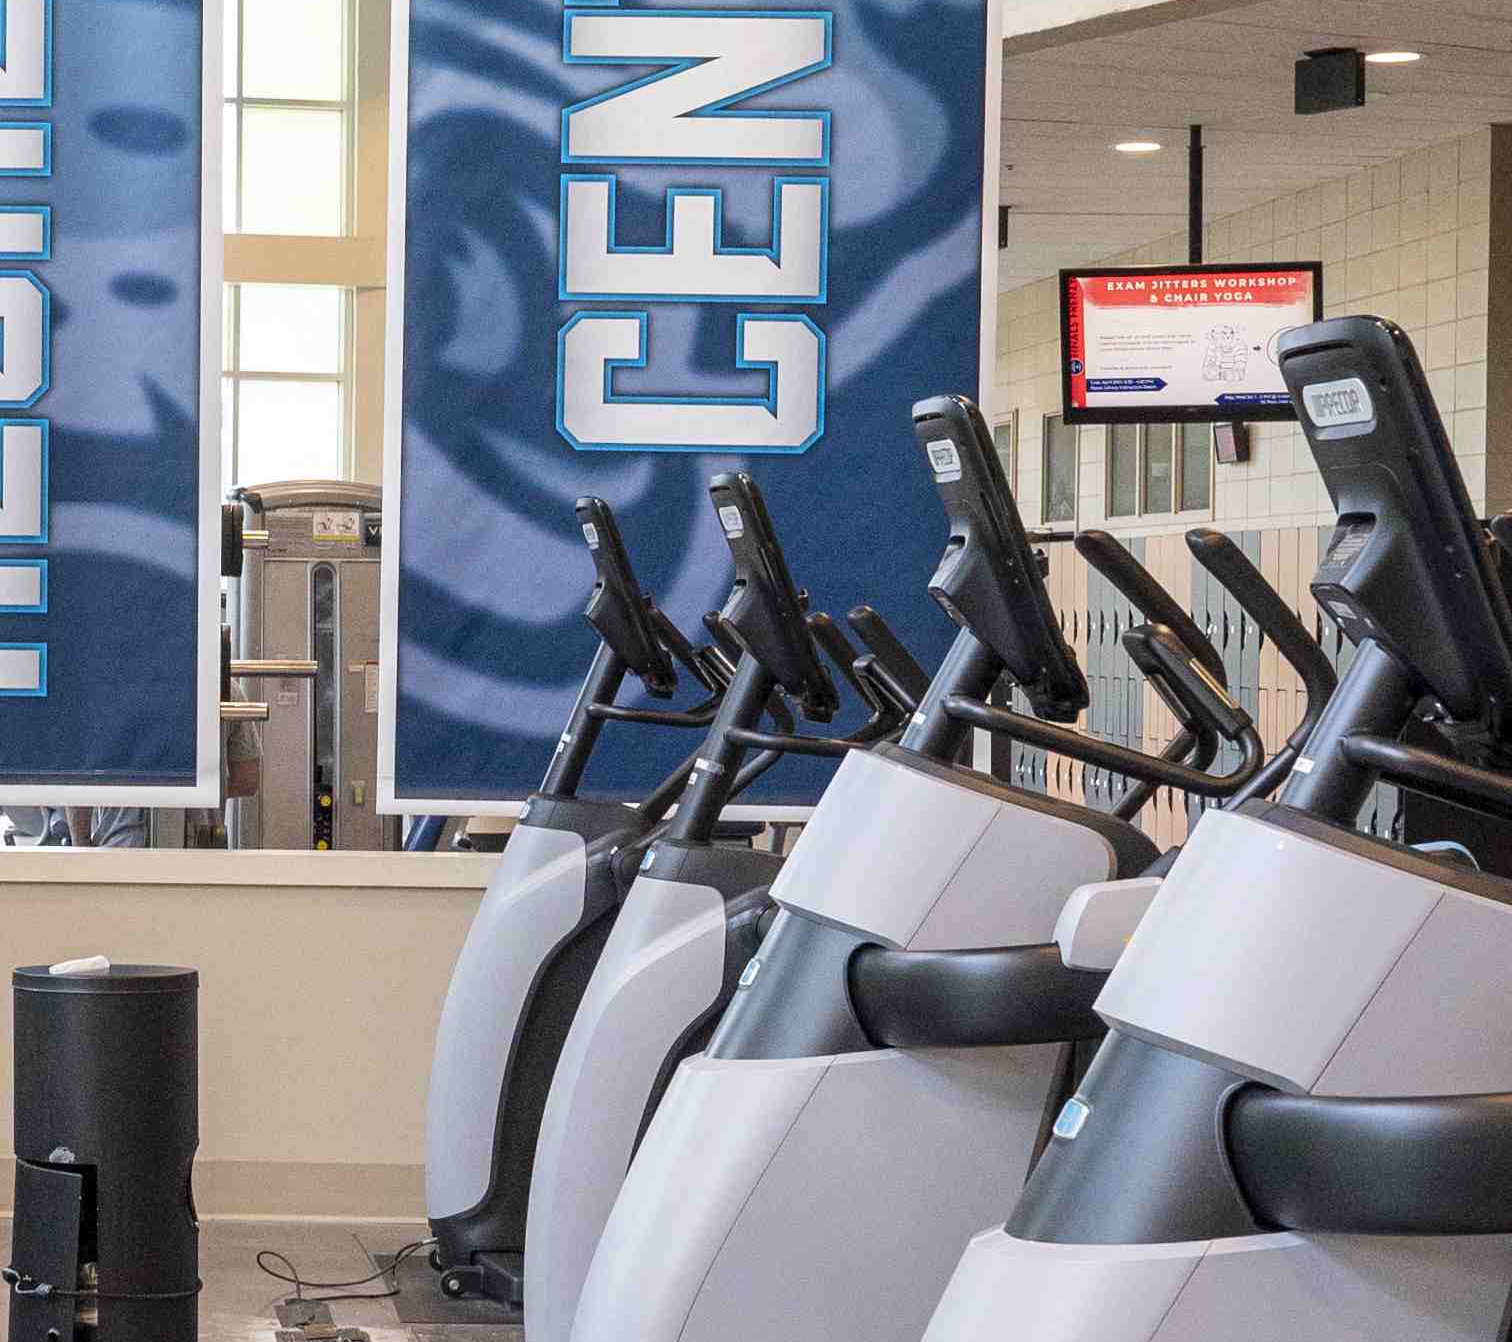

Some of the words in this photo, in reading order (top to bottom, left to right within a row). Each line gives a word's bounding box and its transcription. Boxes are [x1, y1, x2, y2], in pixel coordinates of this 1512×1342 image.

[1107, 281, 1145, 291] EXAM
[1151, 279, 1207, 290] JITTERS
[1214, 277, 1296, 288] WORKSHOP
[1164, 292, 1208, 302] CHAIR
[1214, 291, 1252, 301] YOGA
